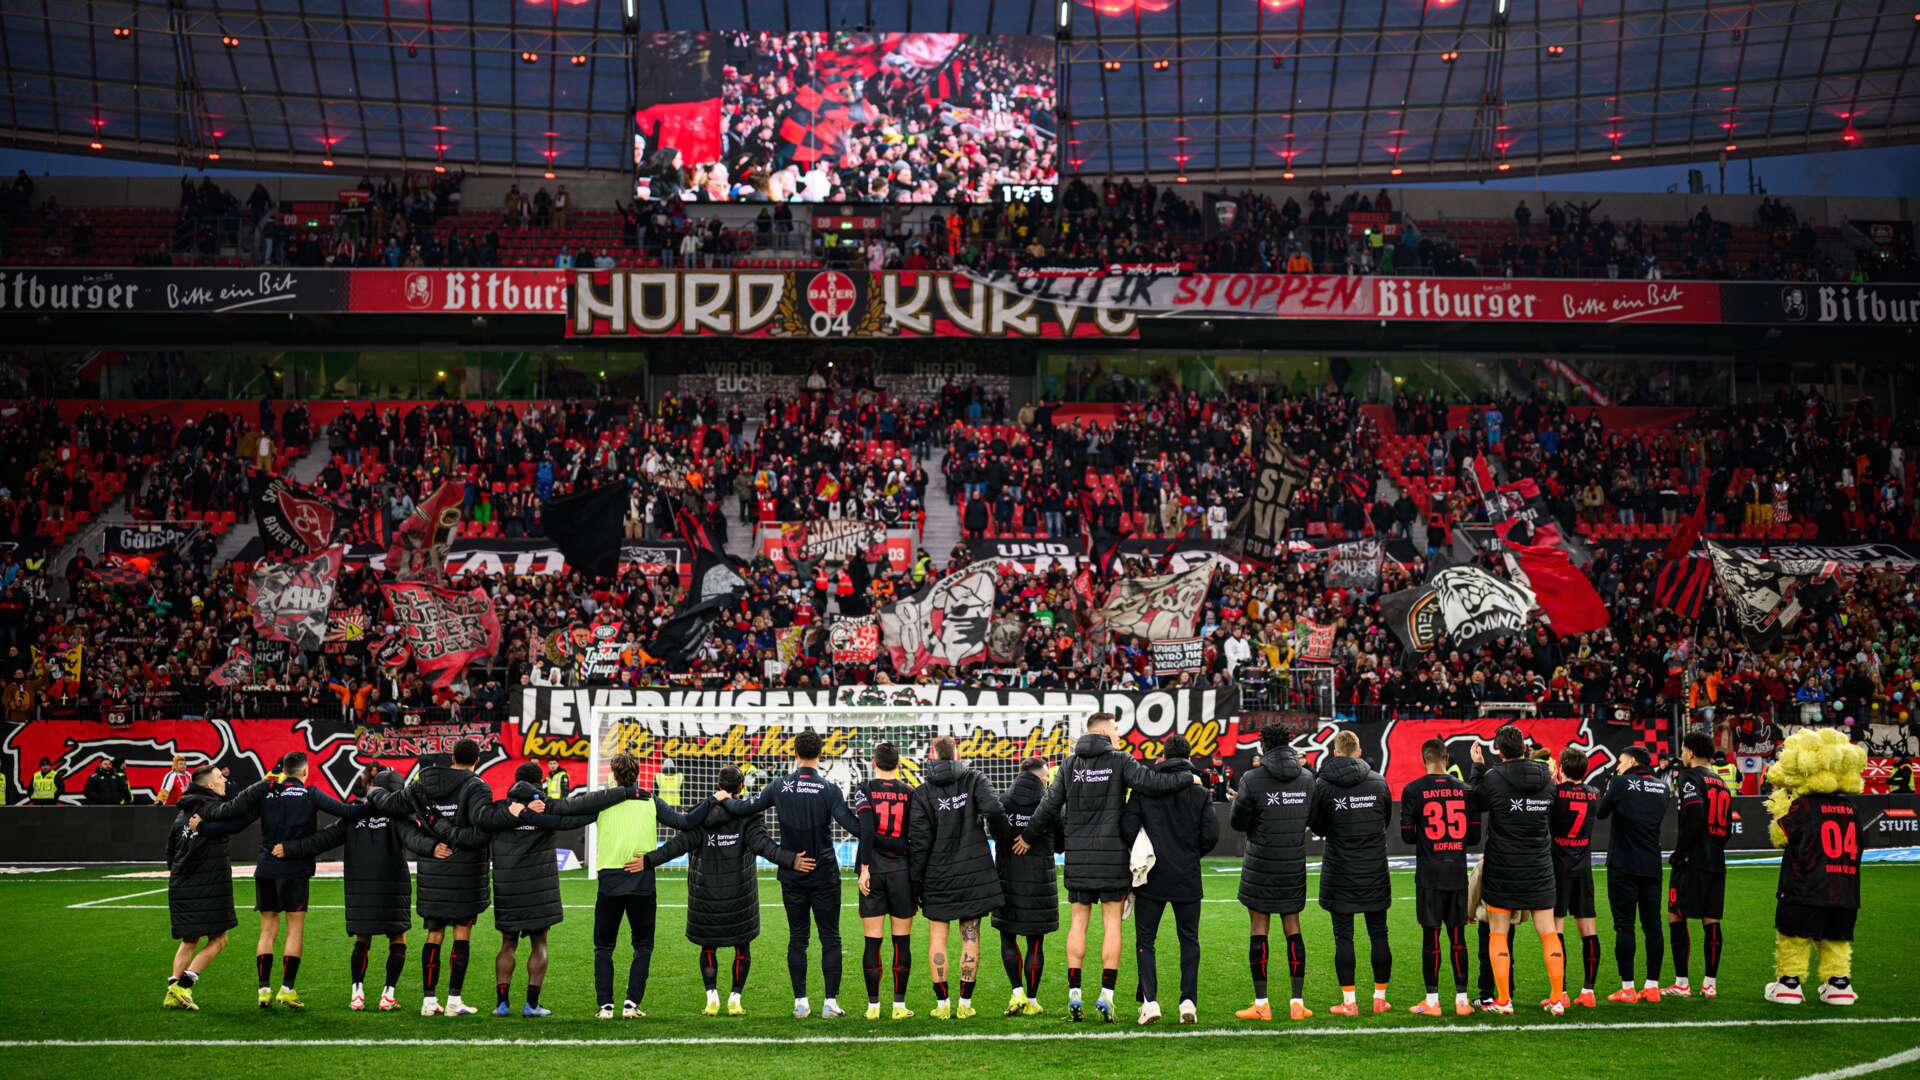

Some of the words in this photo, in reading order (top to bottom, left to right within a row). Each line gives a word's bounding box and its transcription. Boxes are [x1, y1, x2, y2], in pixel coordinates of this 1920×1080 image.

[166, 283, 214, 309] Bitte
[219, 283, 254, 300] ein
[258, 271, 297, 294] Bit
[809, 289, 854, 299] BAYER
[1172, 274, 1363, 312] STOPPEN
[576, 272, 785, 332] NORD
[1377, 279, 1536, 318] Bitburger
[1562, 294, 1608, 319] Bitte
[1612, 292, 1644, 309] ein
[1647, 283, 1683, 305] Bit
[810, 312, 851, 337] 04
[705, 362, 740, 377] WIR
[741, 360, 773, 377] FÜR
[914, 362, 942, 377] IHR
[996, 543, 1070, 558] UND
[254, 650, 285, 662] NICHT
[521, 687, 831, 738] LEVERKUSEN
[662, 723, 751, 758] euch
[758, 720, 859, 758] het
[955, 725, 1019, 760] die
[1139, 719, 1219, 761] vll
[1086, 768, 1113, 776] Barmenia
[796, 780, 824, 790] Barmenia
[796, 786, 820, 794] Gothaer
[871, 791, 897, 801] BAYER
[898, 793, 908, 801] 04
[1282, 791, 1307, 799] Barmenia
[1350, 795, 1377, 804] Barmenia
[1423, 789, 1452, 799] BAYER
[1453, 789, 1464, 798] 04
[1559, 790, 1587, 800] BAYER
[1350, 801, 1374, 809] Gothaer
[1707, 787, 1731, 829] 10
[1820, 804, 1845, 814] BAYER
[875, 801, 904, 838] 11
[1423, 800, 1468, 841] 35
[1568, 801, 1588, 838] 7
[1879, 820, 1920, 833] STUTE
[1433, 842, 1463, 851] KOFANE
[1821, 819, 1858, 861] 04
